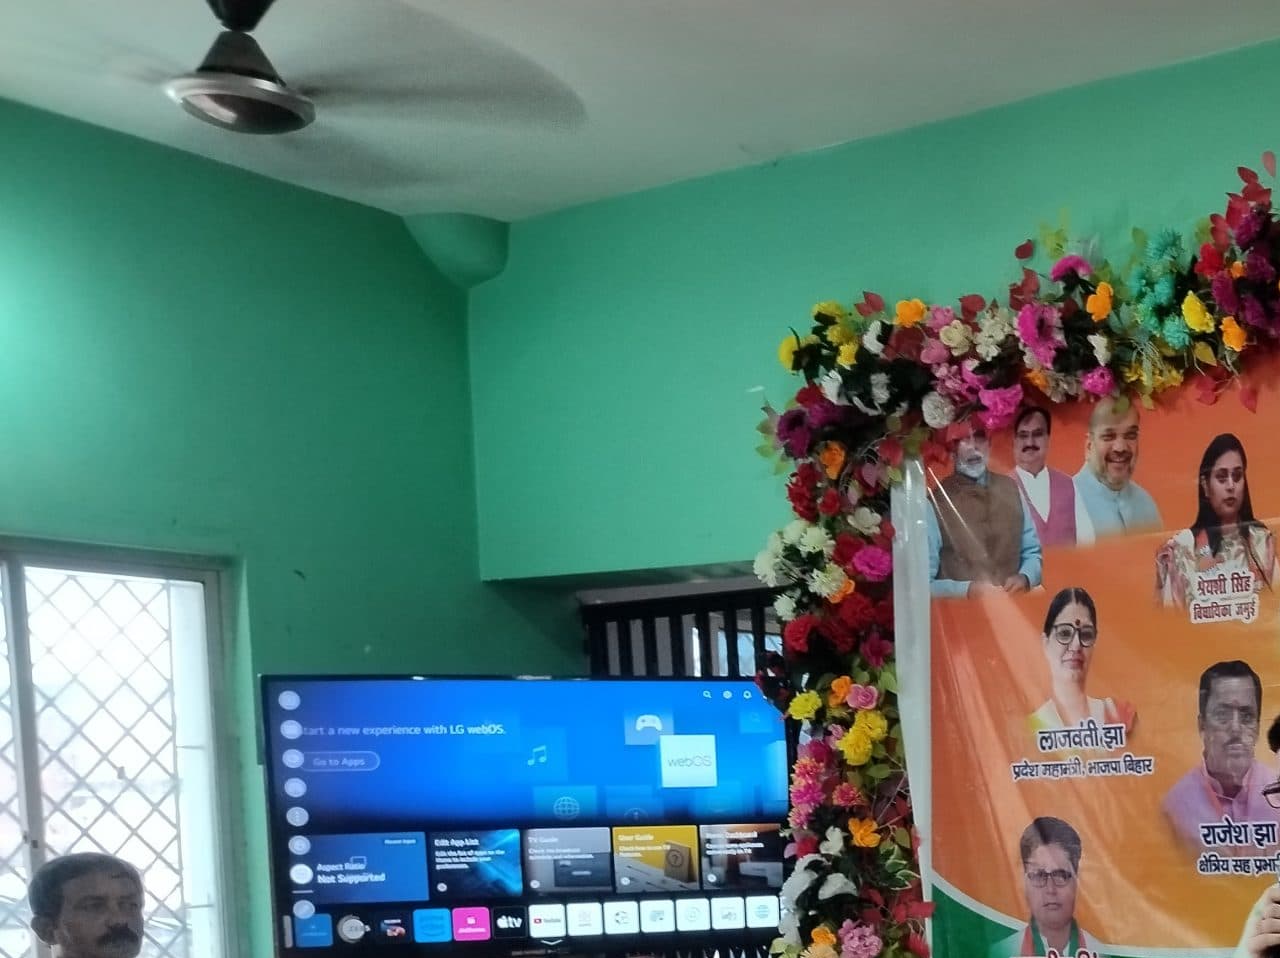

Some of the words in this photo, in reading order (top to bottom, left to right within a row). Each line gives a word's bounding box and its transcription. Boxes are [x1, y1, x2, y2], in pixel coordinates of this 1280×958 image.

[1231, 571, 1250, 593] सिंह
[301, 726, 325, 736] tart
[363, 725, 421, 736] experience
[424, 725, 447, 734] with
[450, 725, 464, 734] LG
[1039, 720, 1099, 750] लाजवंती
[1103, 726, 1123, 748] झा
[1013, 761, 1038, 779] प्रदेश
[1088, 761, 1120, 774] भाजपा
[1201, 818, 1248, 844] राजेश
[1254, 824, 1276, 846] झा
[1232, 860, 1250, 873] सह
